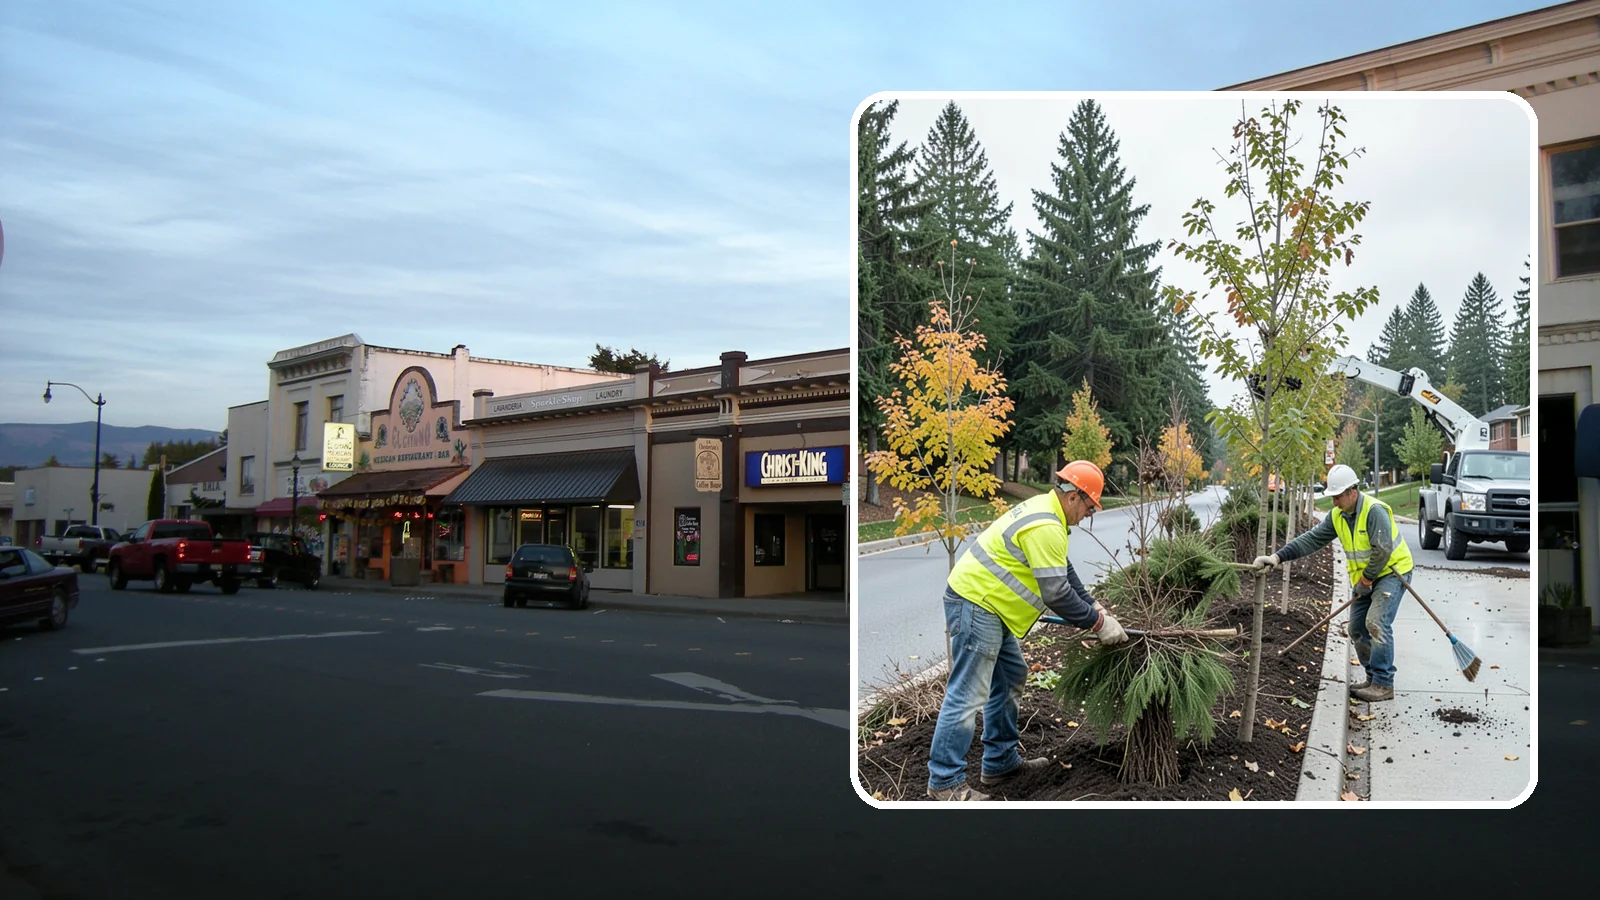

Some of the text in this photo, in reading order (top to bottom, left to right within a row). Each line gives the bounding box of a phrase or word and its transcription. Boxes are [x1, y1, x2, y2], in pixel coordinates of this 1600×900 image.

[493, 389, 623, 412] LAVANDERIA Sparkle Shop LAUNDRY
[373, 455, 396, 464] MEXICAN
[398, 451, 434, 462] RESTAURANT
[437, 450, 450, 459] BAR
[761, 449, 827, 478] CHRIST KING
[710, 481, 721, 489] House
